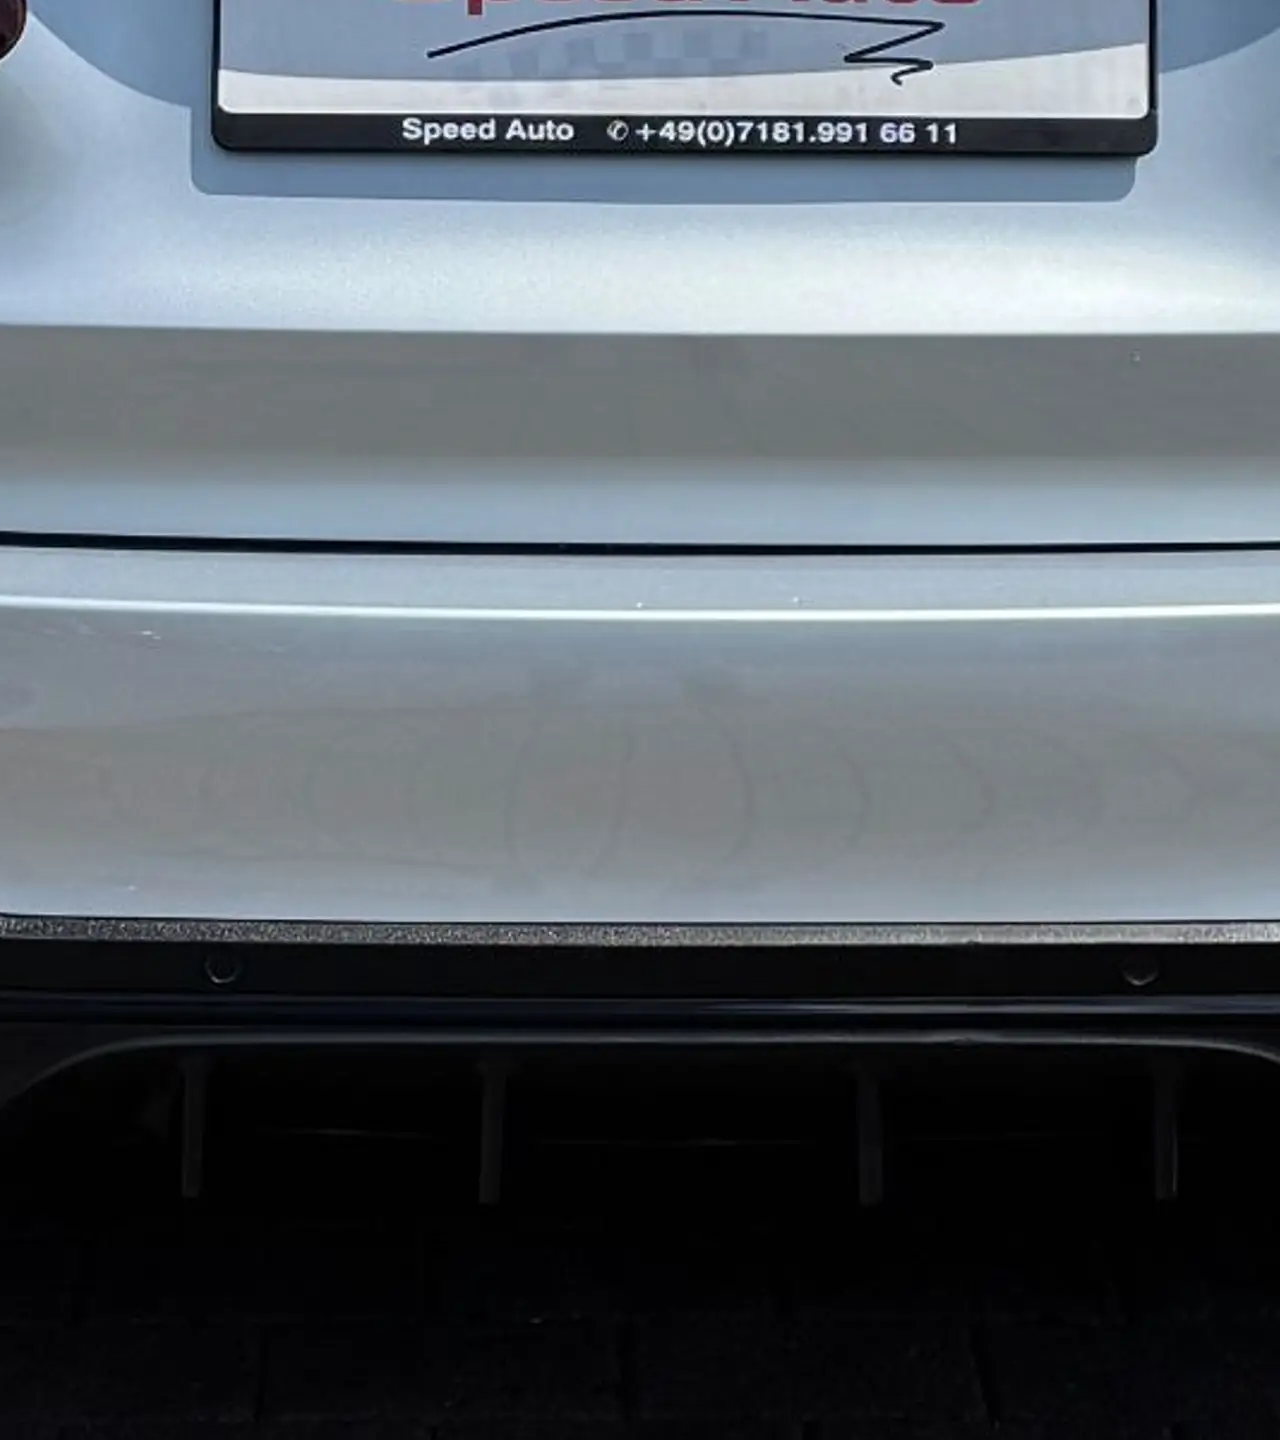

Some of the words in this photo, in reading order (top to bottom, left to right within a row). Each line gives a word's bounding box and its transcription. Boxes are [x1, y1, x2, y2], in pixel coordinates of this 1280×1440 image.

[402, 117, 496, 146] Speed
[505, 118, 574, 142] Auto
[635, 120, 867, 147] +49(0)7181.991
[879, 122, 917, 144] 66
[926, 122, 957, 144] 11
